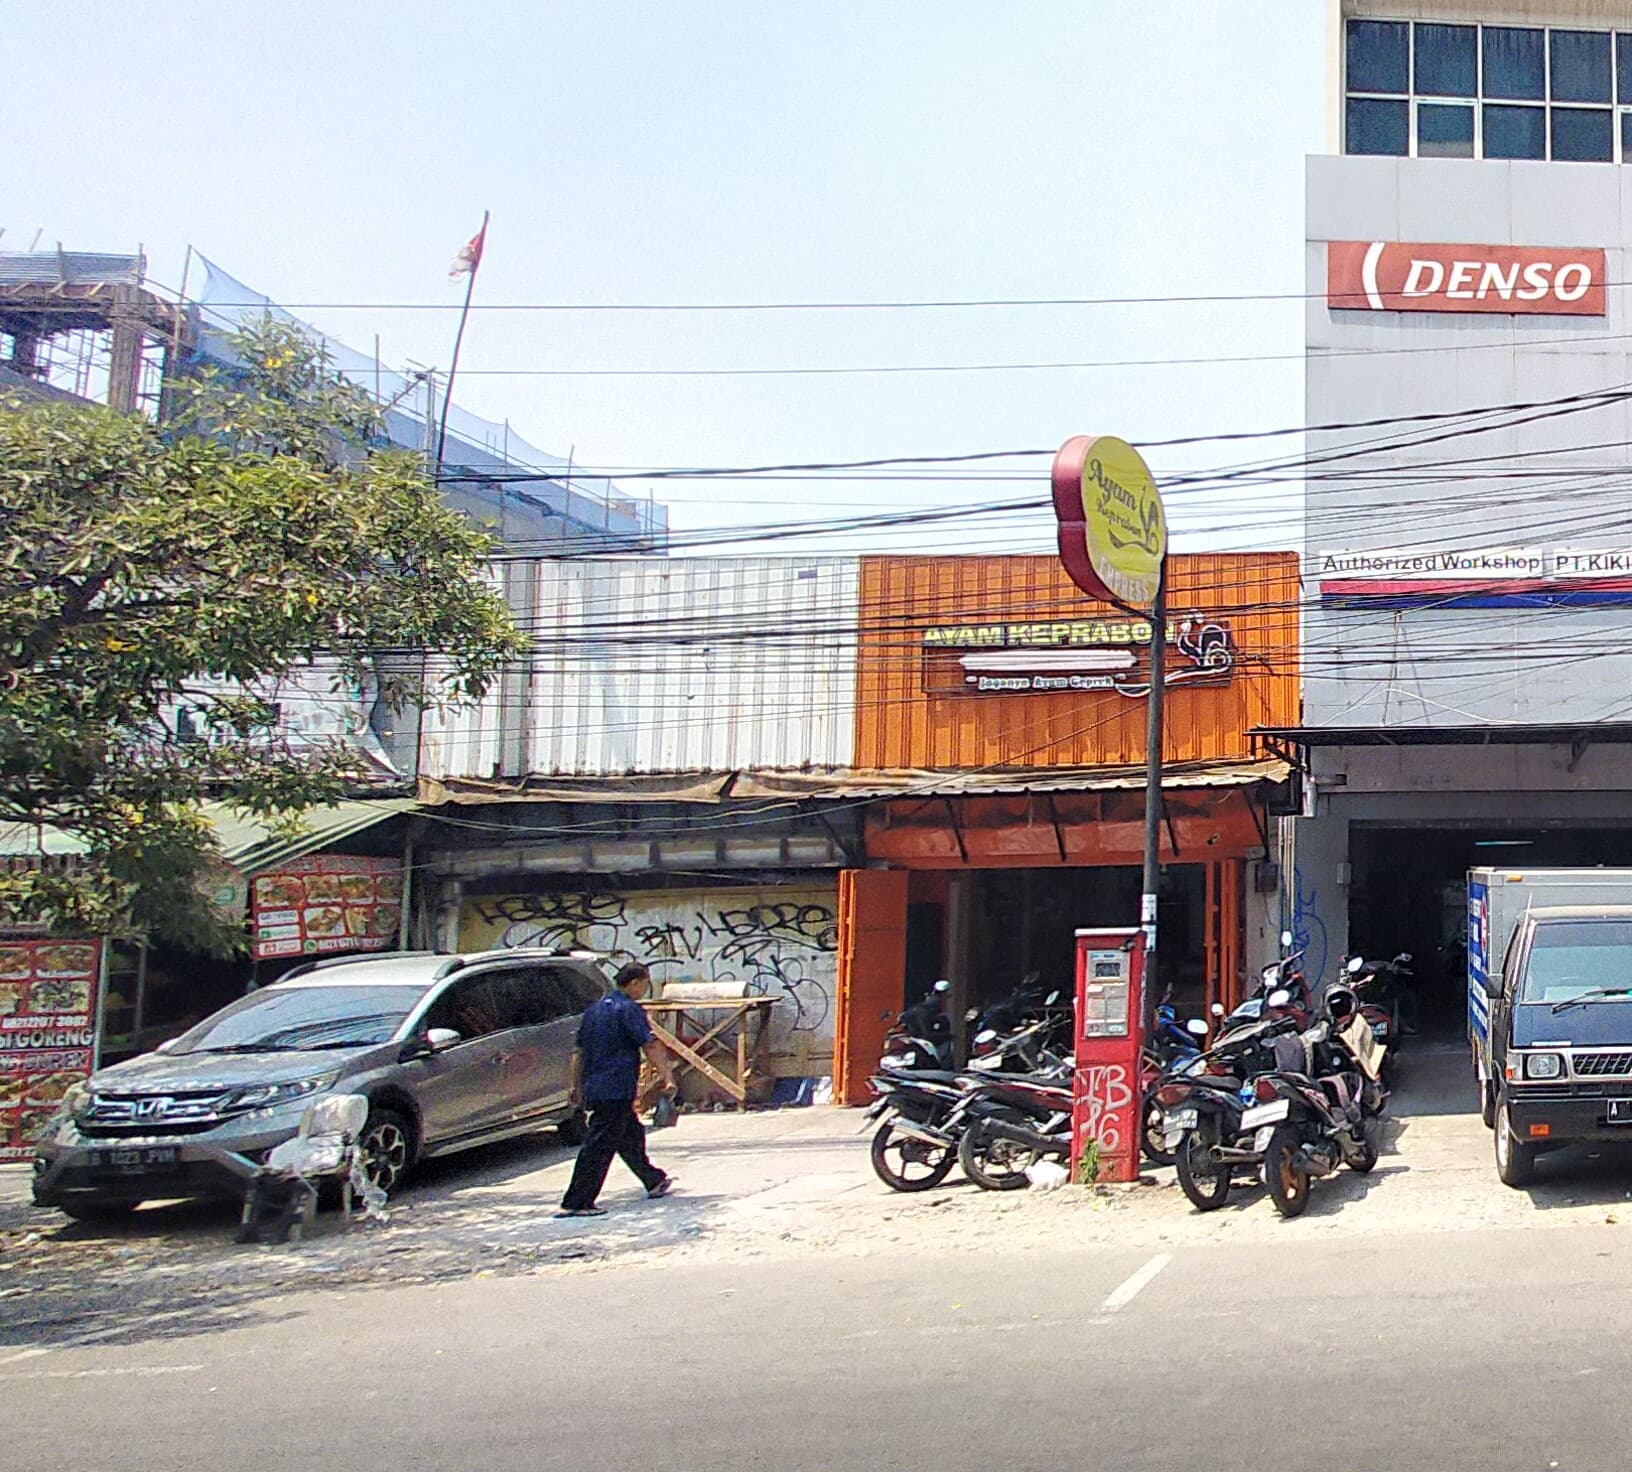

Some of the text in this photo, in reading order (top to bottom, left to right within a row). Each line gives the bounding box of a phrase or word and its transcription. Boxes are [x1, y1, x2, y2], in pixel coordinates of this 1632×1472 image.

[1402, 258, 1592, 302] DENSO
[1088, 458, 1138, 511] Ayam
[1323, 554, 1540, 572] Authorized Workshop
[924, 621, 1178, 647] AYAM KEPRABON
